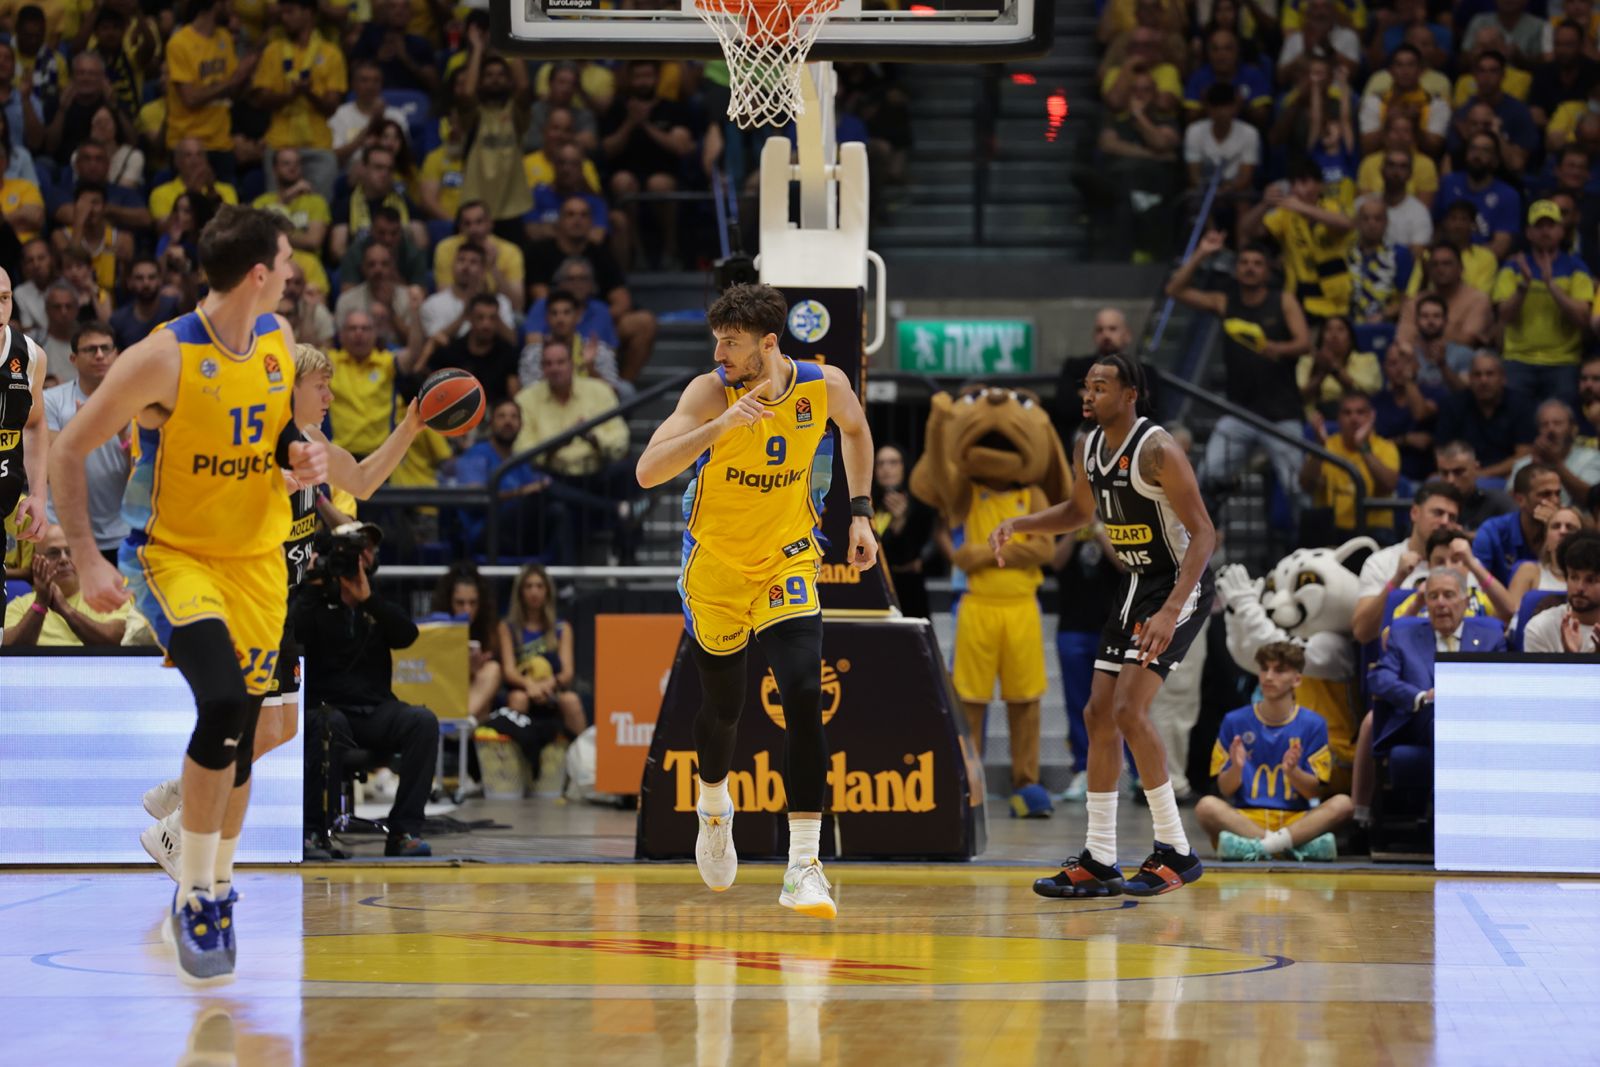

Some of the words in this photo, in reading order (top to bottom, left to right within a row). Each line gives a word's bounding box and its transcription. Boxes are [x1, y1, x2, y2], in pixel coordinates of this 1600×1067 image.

[549, 0, 592, 8] EuroLeague
[229, 403, 266, 446] 15
[766, 435, 787, 466] 9
[786, 576, 808, 604] 9
